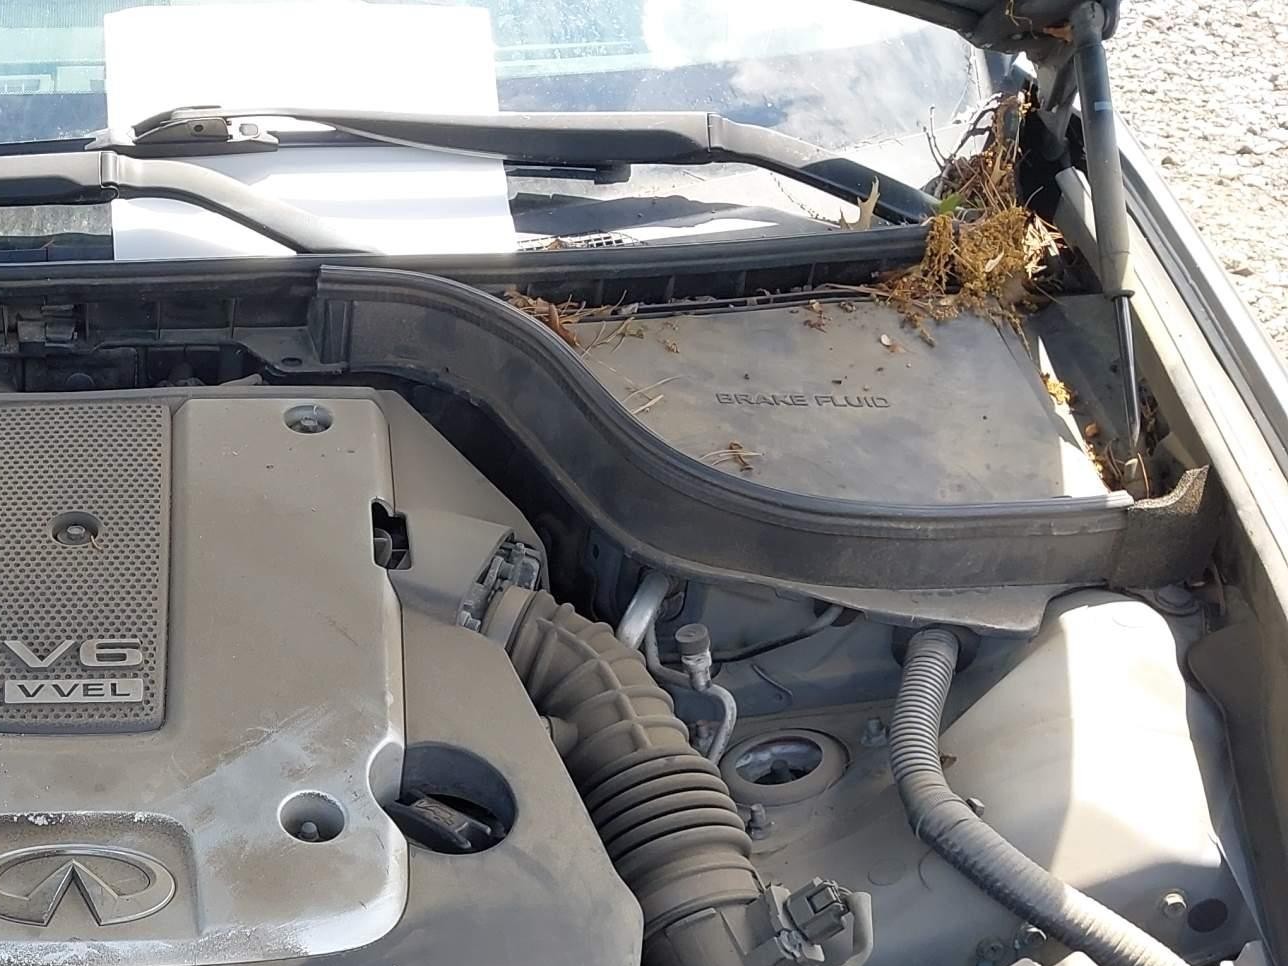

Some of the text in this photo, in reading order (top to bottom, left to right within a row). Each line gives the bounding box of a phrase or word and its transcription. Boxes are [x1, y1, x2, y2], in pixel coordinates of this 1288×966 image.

[714, 392, 891, 409] BRAKE FLUID
[3, 638, 144, 669] V6
[16, 682, 132, 699] VVEL
